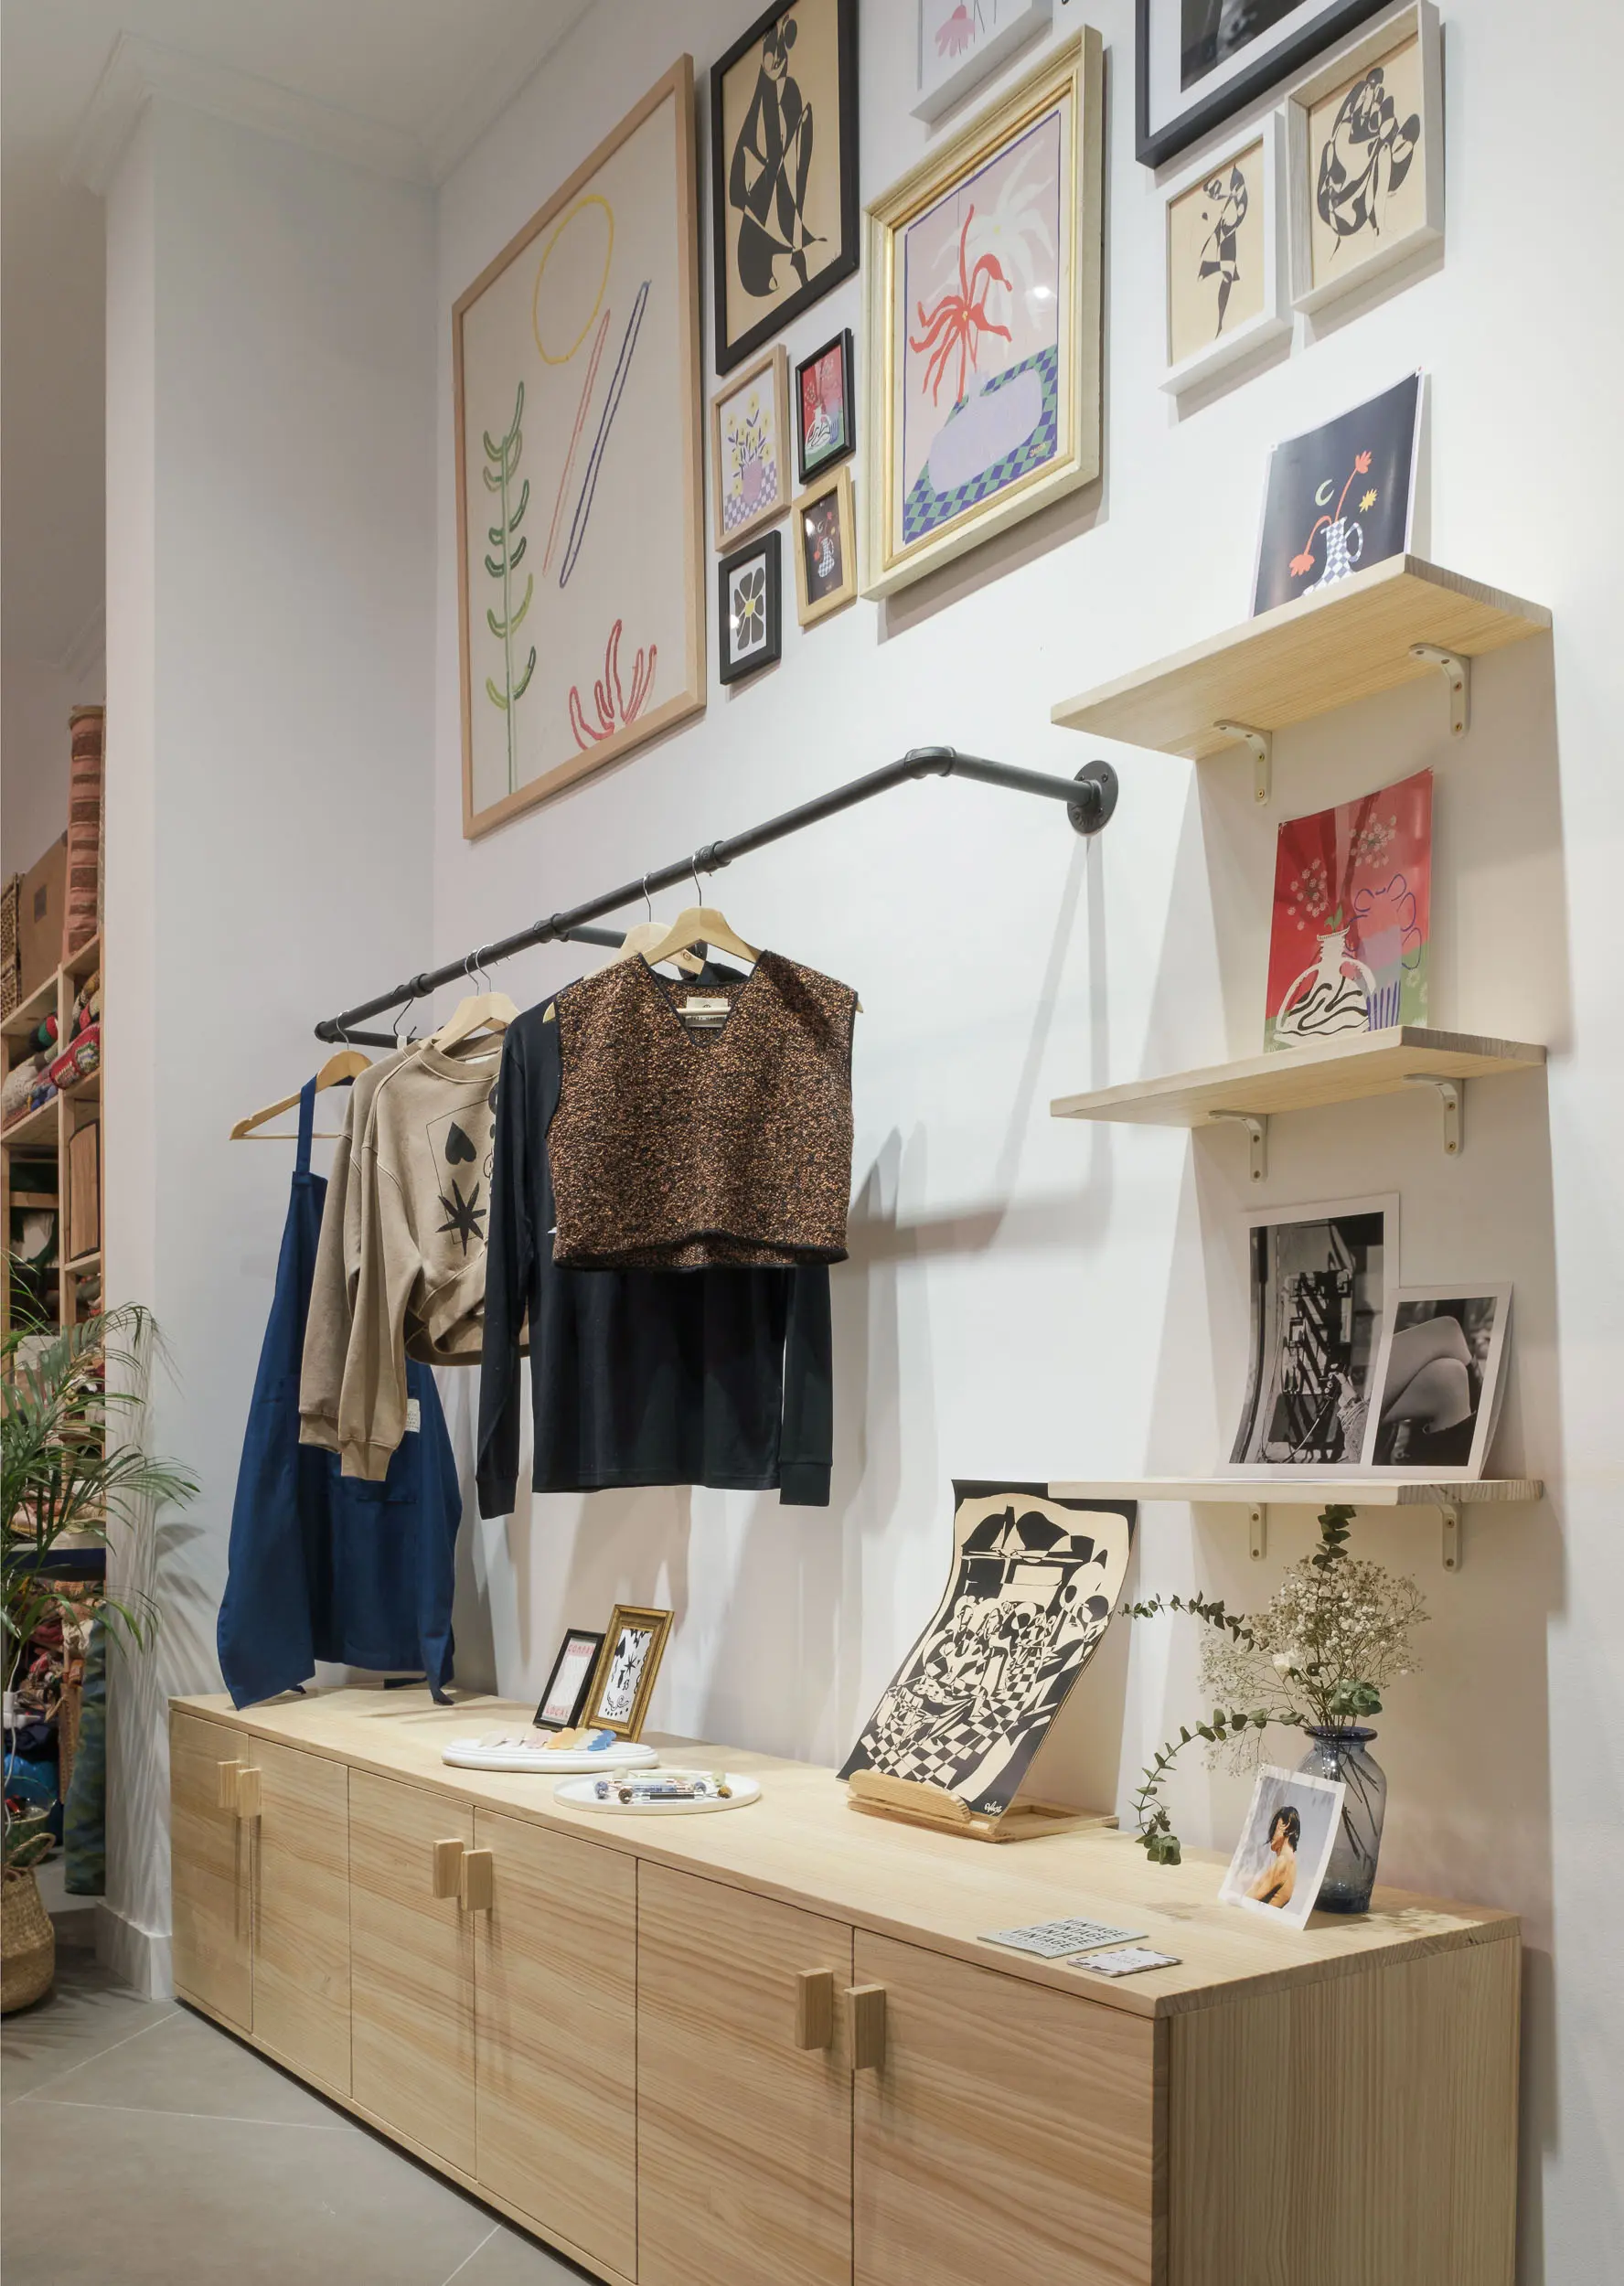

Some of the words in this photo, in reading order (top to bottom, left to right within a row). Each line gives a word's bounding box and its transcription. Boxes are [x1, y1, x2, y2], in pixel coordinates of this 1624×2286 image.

[1030, 1926, 1095, 1944] VINTAGE
[1047, 1923, 1112, 1940] VINTAGE
[1063, 1919, 1128, 1937] VINTAGE
[1011, 1929, 1077, 1948] VINTAGE
